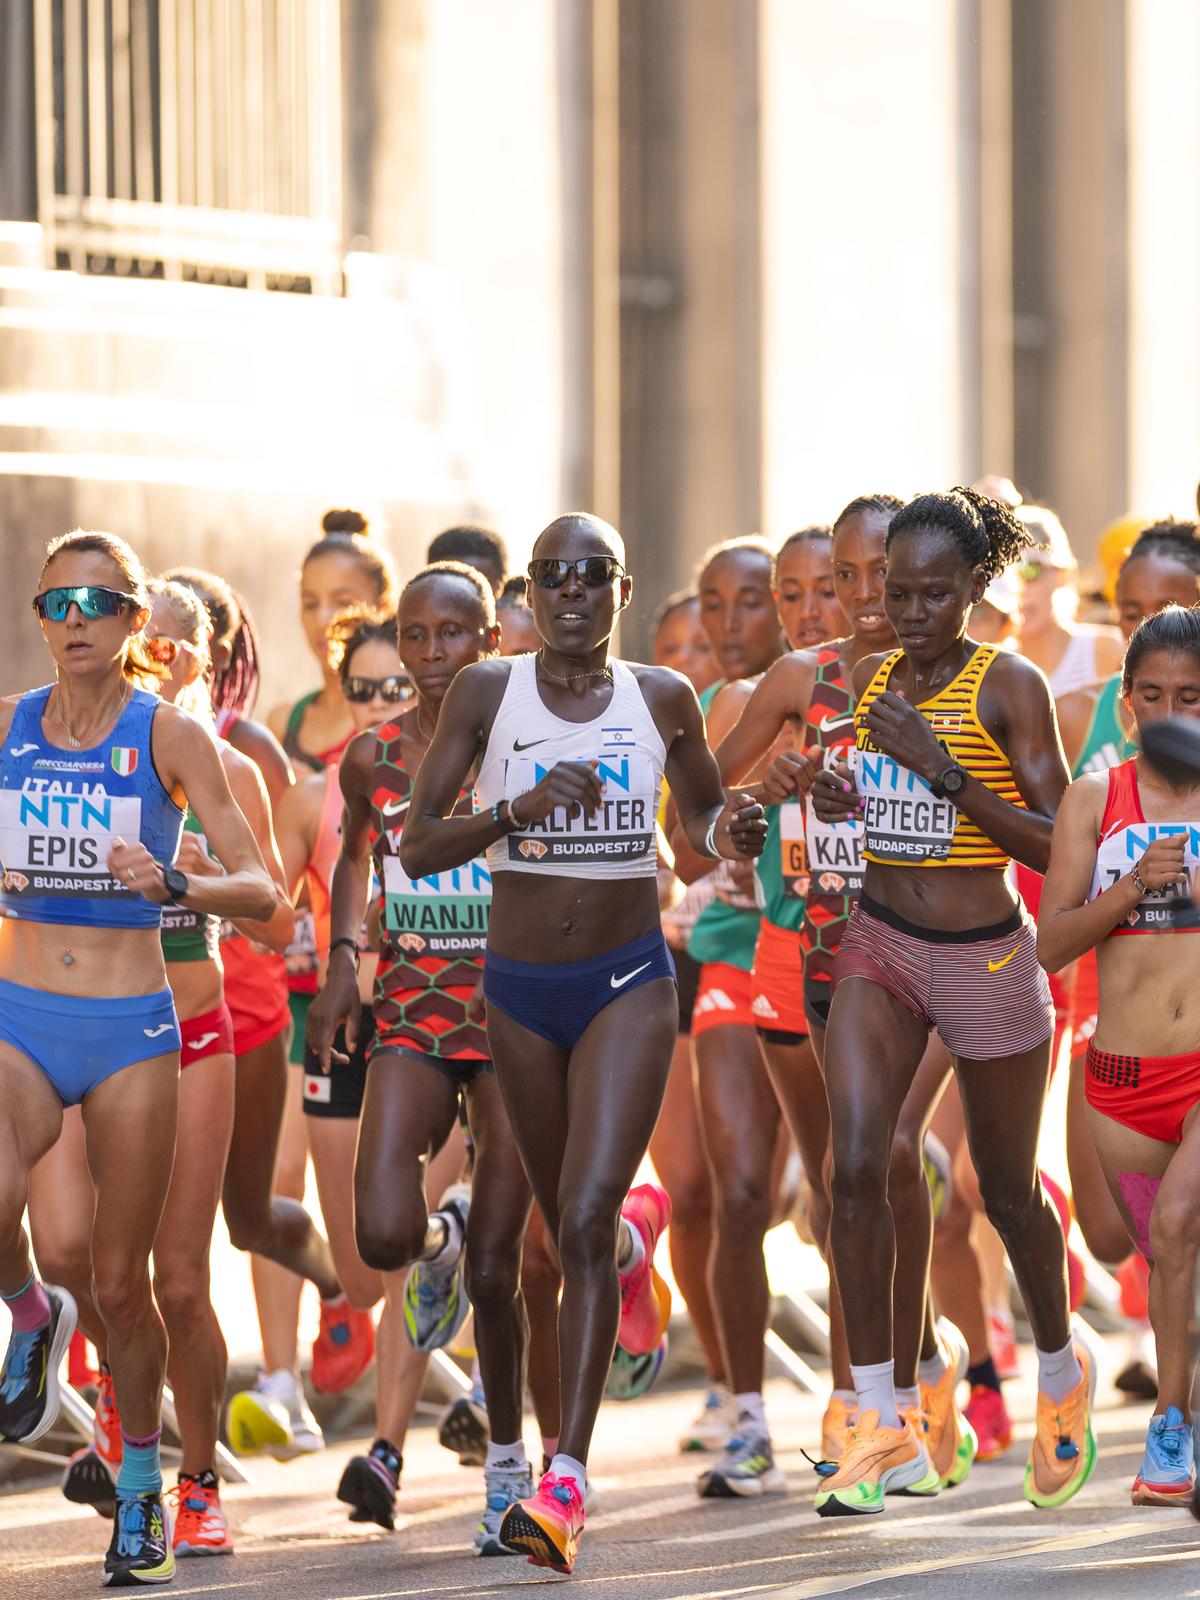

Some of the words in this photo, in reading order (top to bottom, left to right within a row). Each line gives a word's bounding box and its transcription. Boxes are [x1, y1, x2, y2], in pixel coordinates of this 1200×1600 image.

[21, 776, 108, 798] ITALIA
[20, 793, 112, 833] NTN
[518, 799, 645, 833] ALPETER
[864, 795, 954, 835] EPTEGEI
[27, 834, 98, 869] EPIS
[552, 842, 631, 856] BUDAPEST
[631, 840, 646, 853] 23
[868, 838, 933, 856] BUDAPEST
[33, 876, 112, 892] BUDAPEST
[393, 902, 491, 931] WANJI
